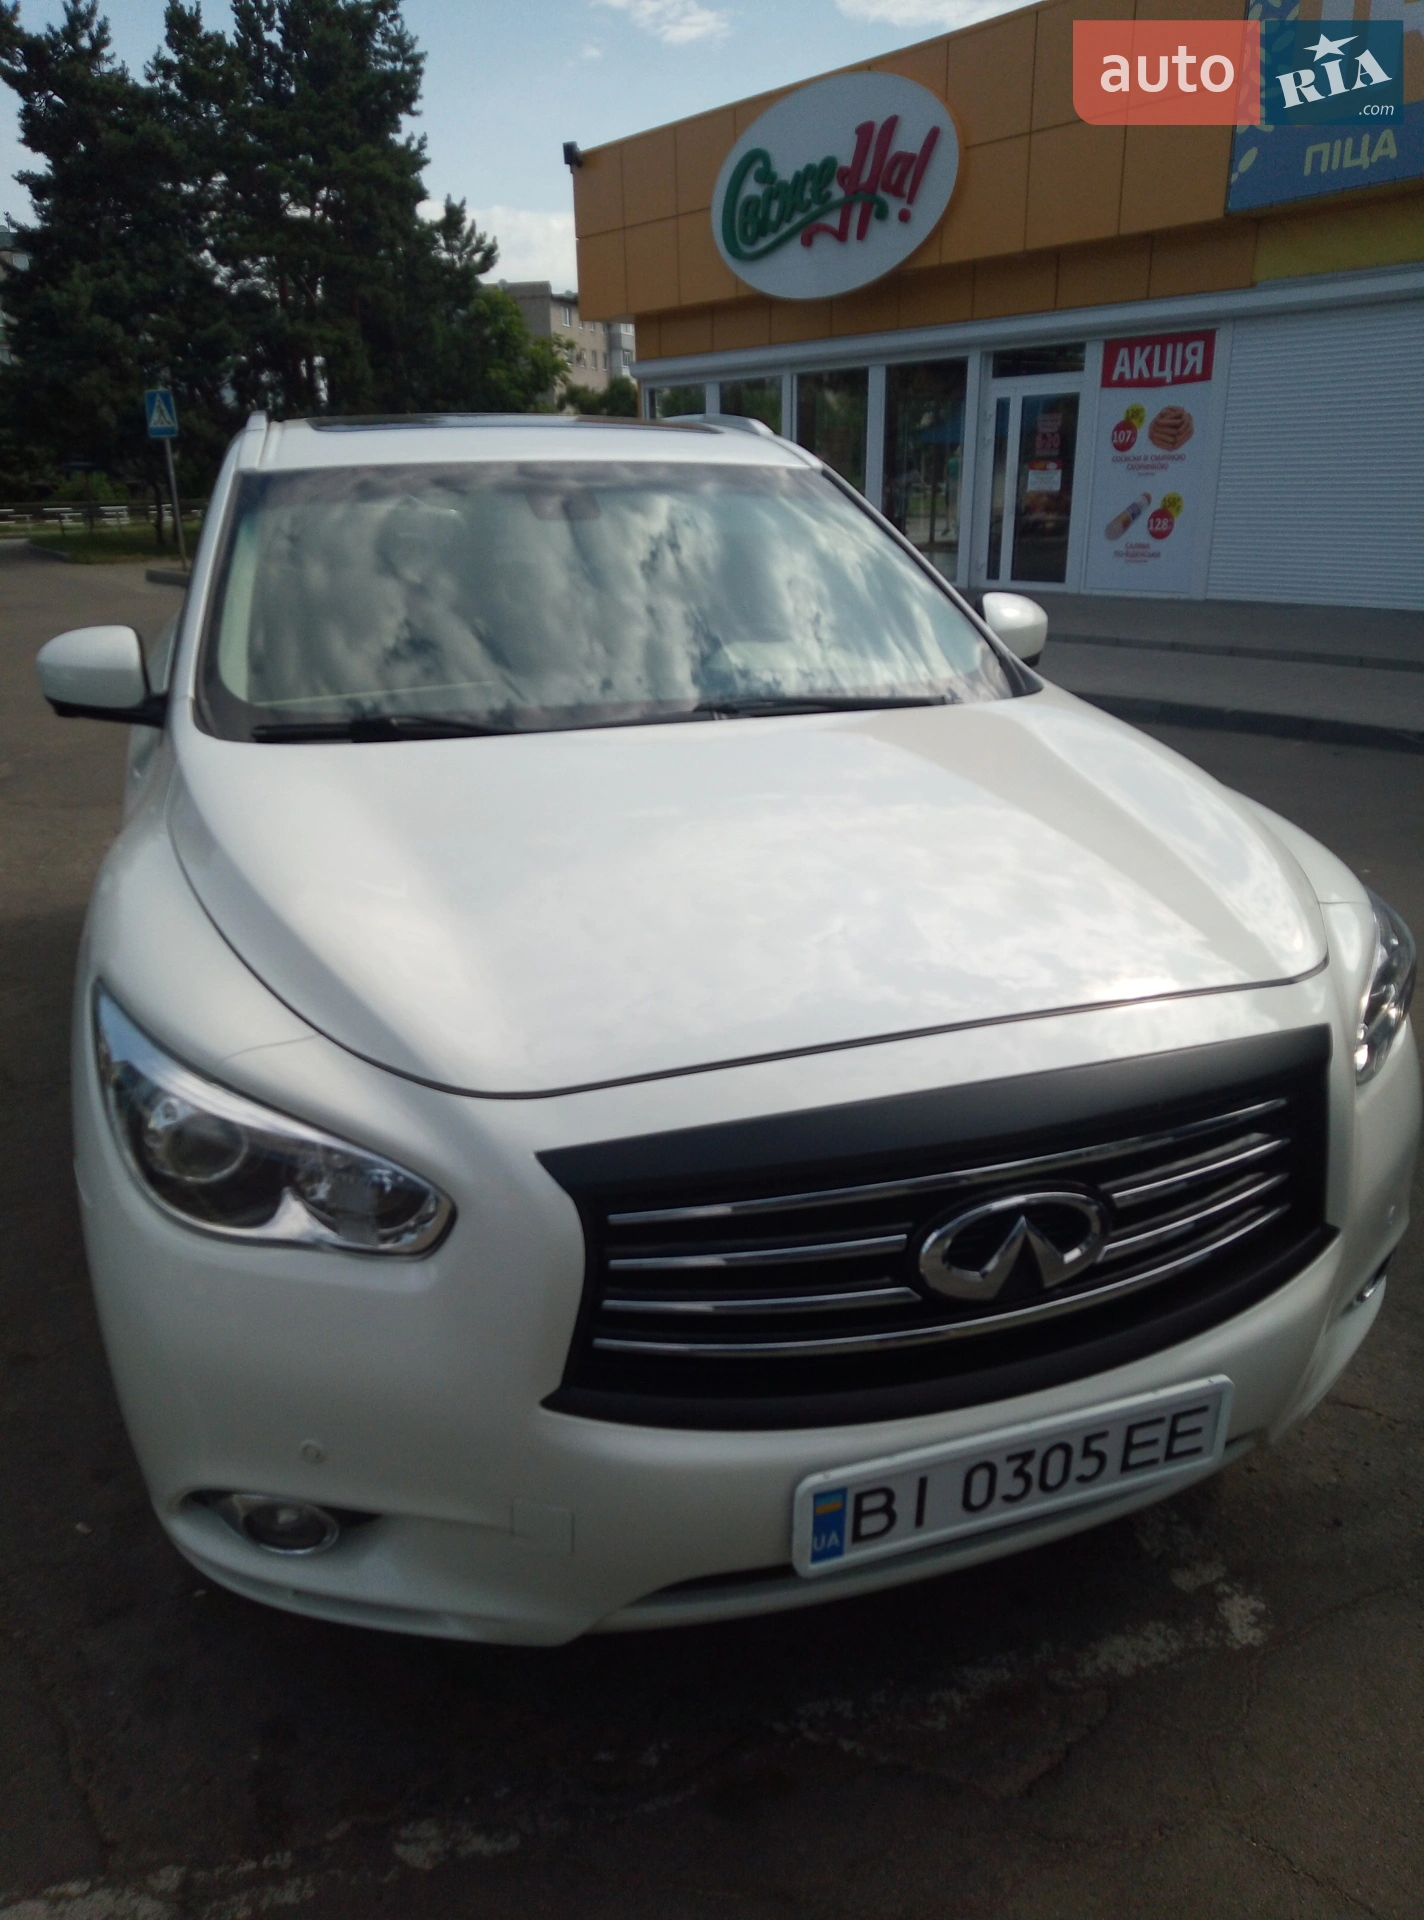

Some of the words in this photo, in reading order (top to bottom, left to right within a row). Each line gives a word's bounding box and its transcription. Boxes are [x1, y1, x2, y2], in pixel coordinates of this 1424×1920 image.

[1303, 128, 1398, 177] ПІЦА
[1111, 340, 1205, 383] АКЦІЯ
[1112, 430, 1132, 444] 107
[1149, 518, 1168, 531] 128
[851, 1476, 929, 1544] BI
[961, 1430, 1108, 1514] 0305
[1119, 1405, 1209, 1474] EE
[813, 1530, 840, 1552] UA
